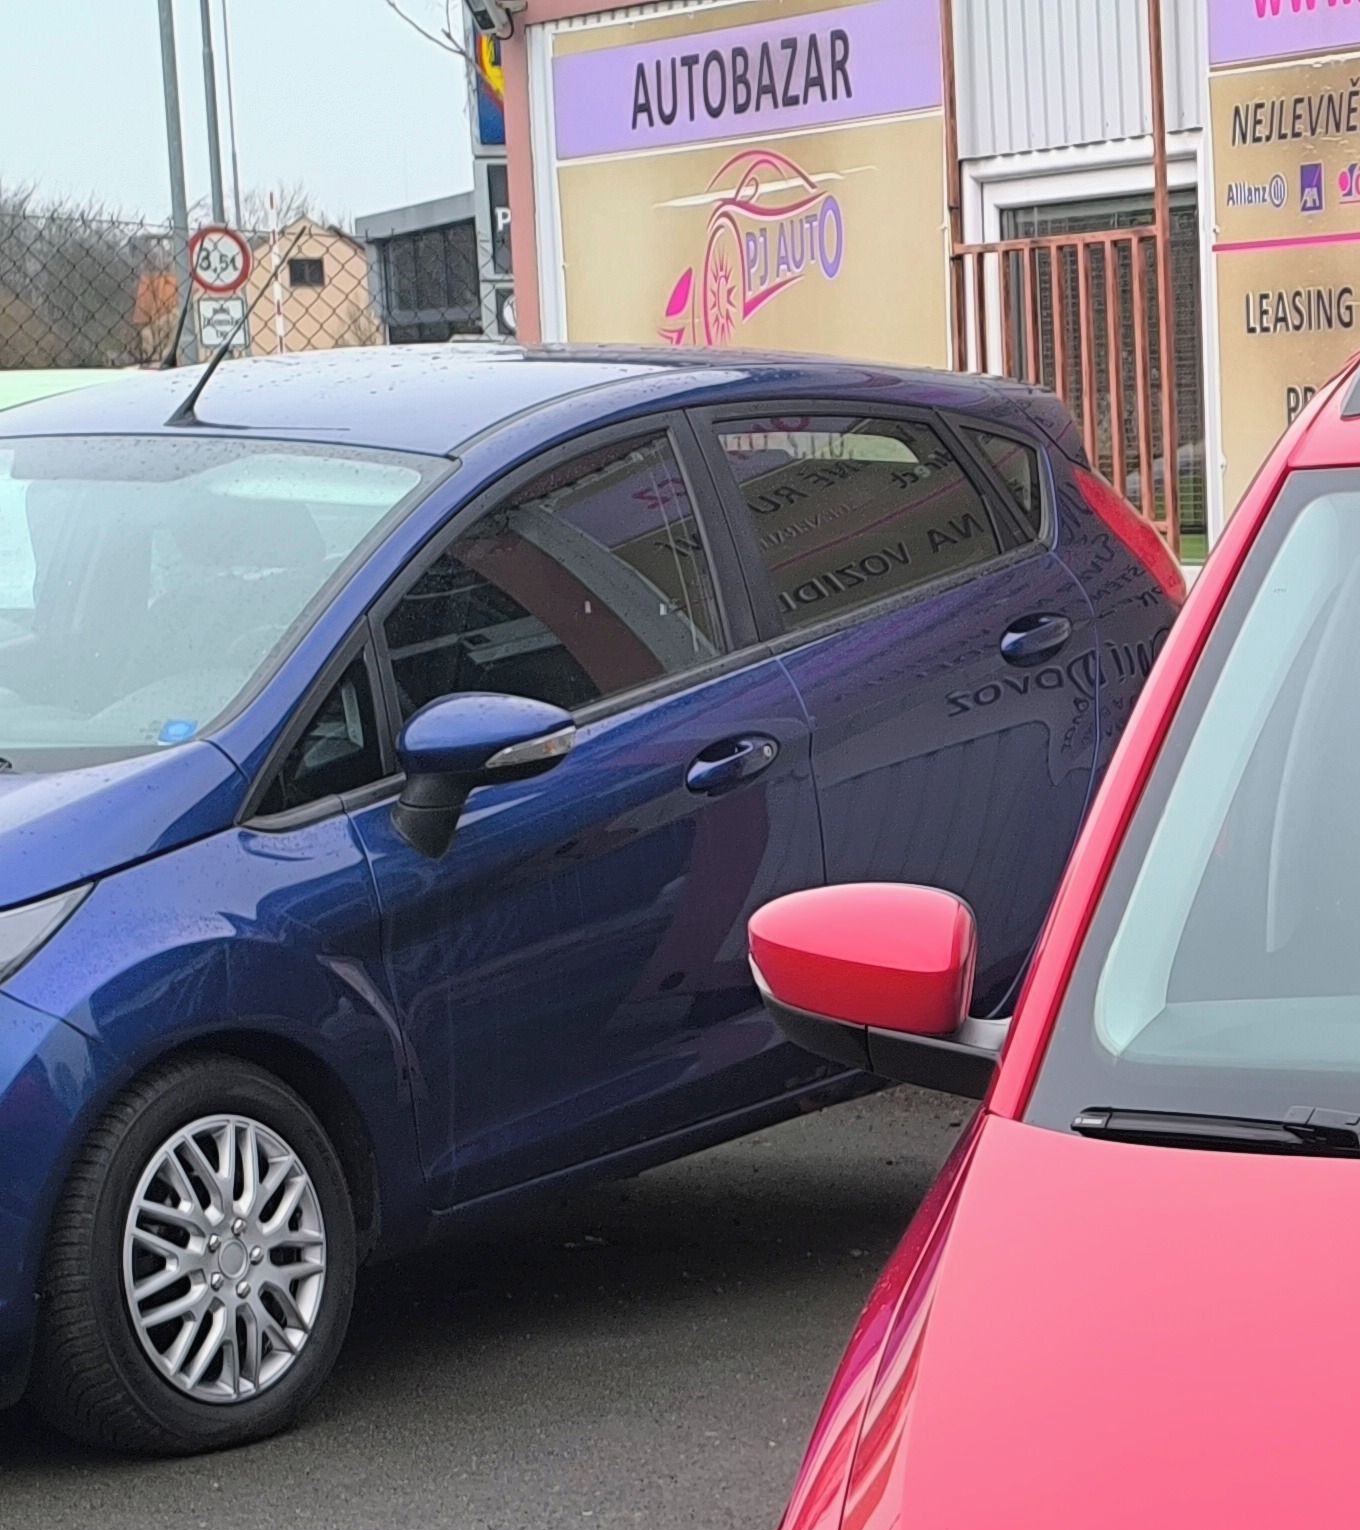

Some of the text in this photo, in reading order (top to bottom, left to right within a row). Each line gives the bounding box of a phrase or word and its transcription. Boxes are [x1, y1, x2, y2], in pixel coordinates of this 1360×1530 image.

[632, 28, 853, 130] AUTOBAZAR
[1227, 181, 1268, 207] Allianz
[745, 195, 843, 292] PJ AUTO
[1245, 287, 1354, 335] LEASING
